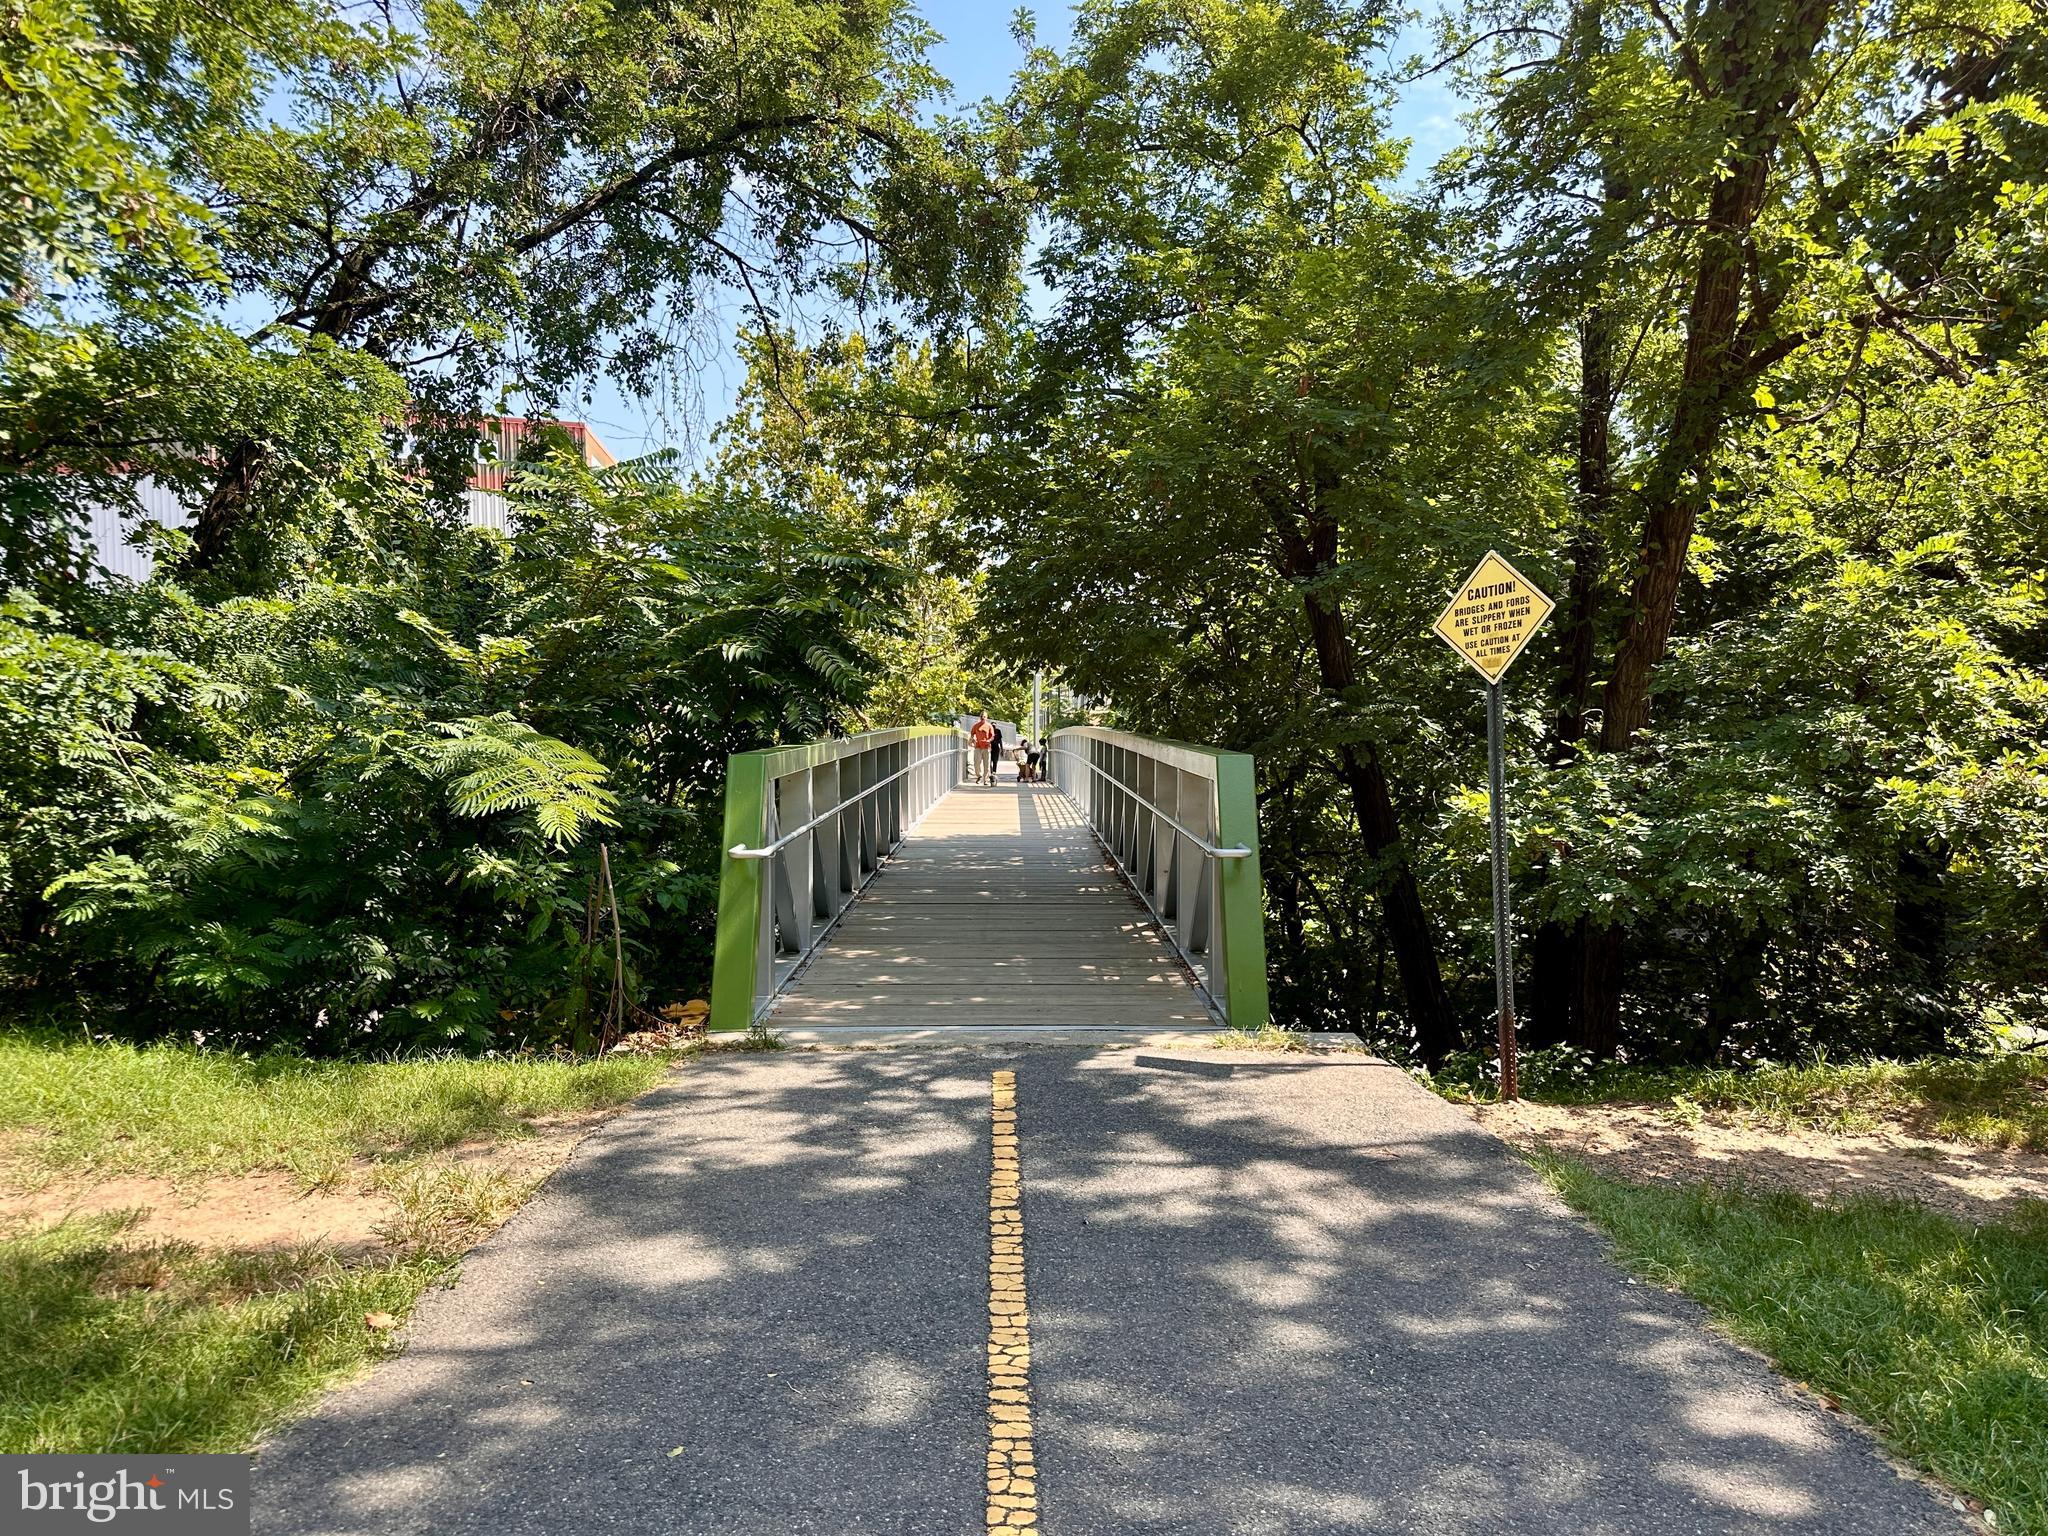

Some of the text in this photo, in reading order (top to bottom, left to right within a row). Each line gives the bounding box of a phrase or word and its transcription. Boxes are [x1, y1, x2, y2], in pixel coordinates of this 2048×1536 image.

[1468, 581, 1516, 601] CAUTION!
[1455, 596, 1530, 617] BRIDGES AND FORDS
[1455, 607, 1530, 628] ARE SLIPPERY WHEN
[1463, 619, 1522, 636] WET OR FROZEN
[1465, 633, 1520, 649] USE CAUTION AT
[1491, 645, 1510, 655] TIMES
